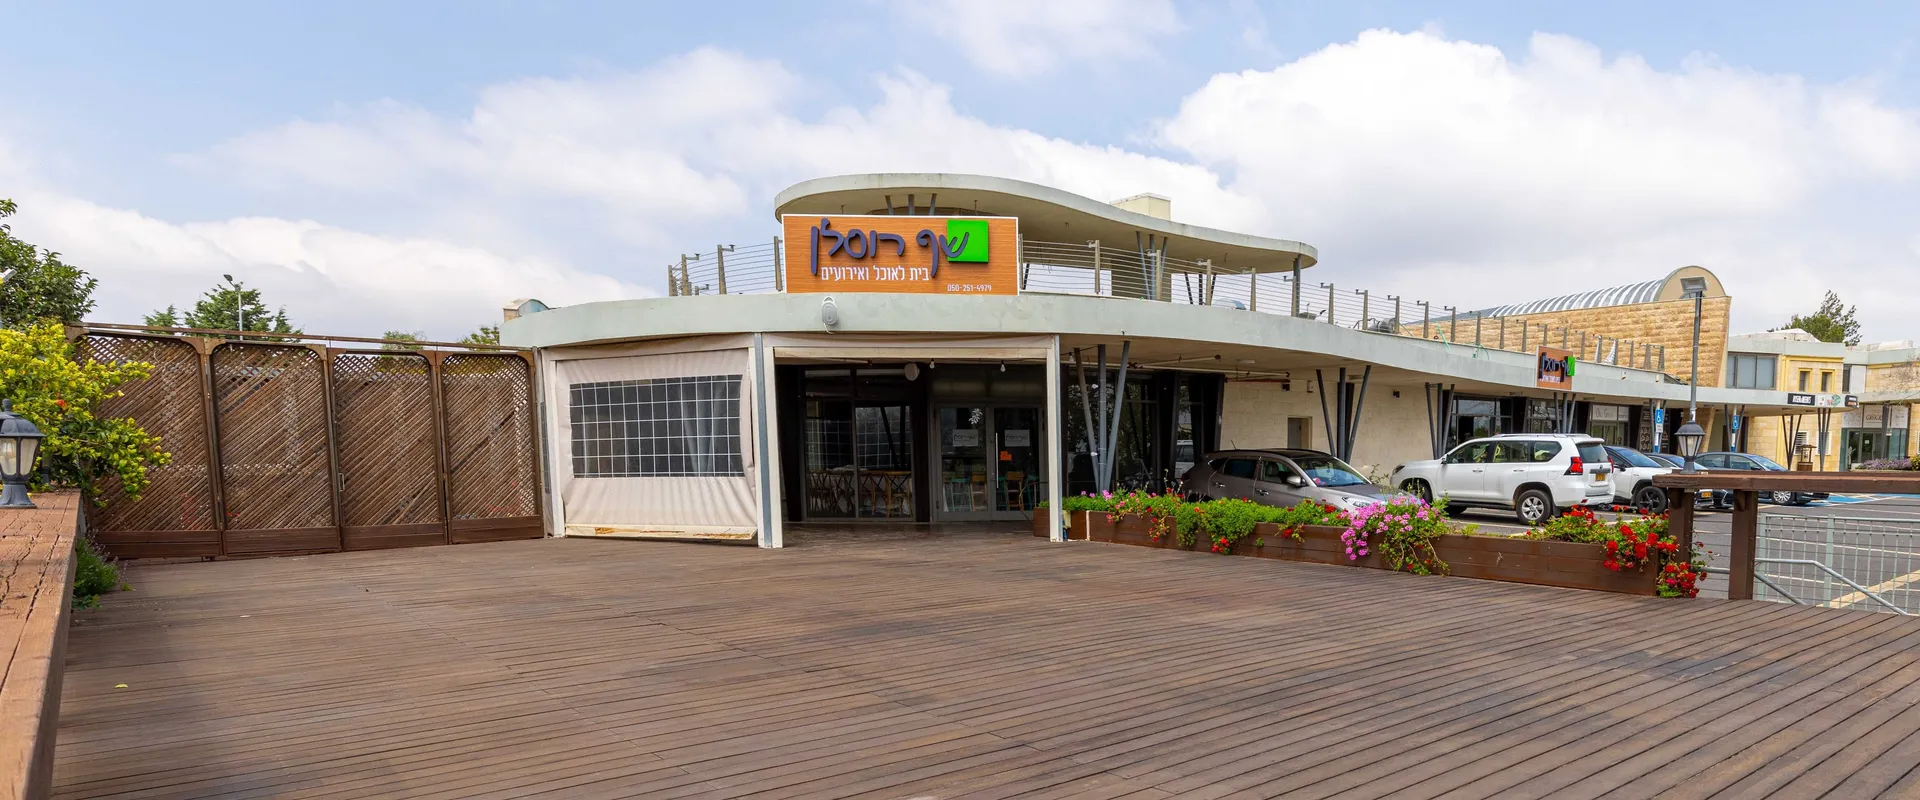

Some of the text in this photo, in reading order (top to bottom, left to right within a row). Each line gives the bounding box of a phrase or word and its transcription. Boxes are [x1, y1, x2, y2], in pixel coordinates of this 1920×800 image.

[811, 217, 970, 278] שף רוסלן
[821, 265, 930, 282] בית לאוכל ואירועים
[947, 284, 992, 292] 050-251-4979
